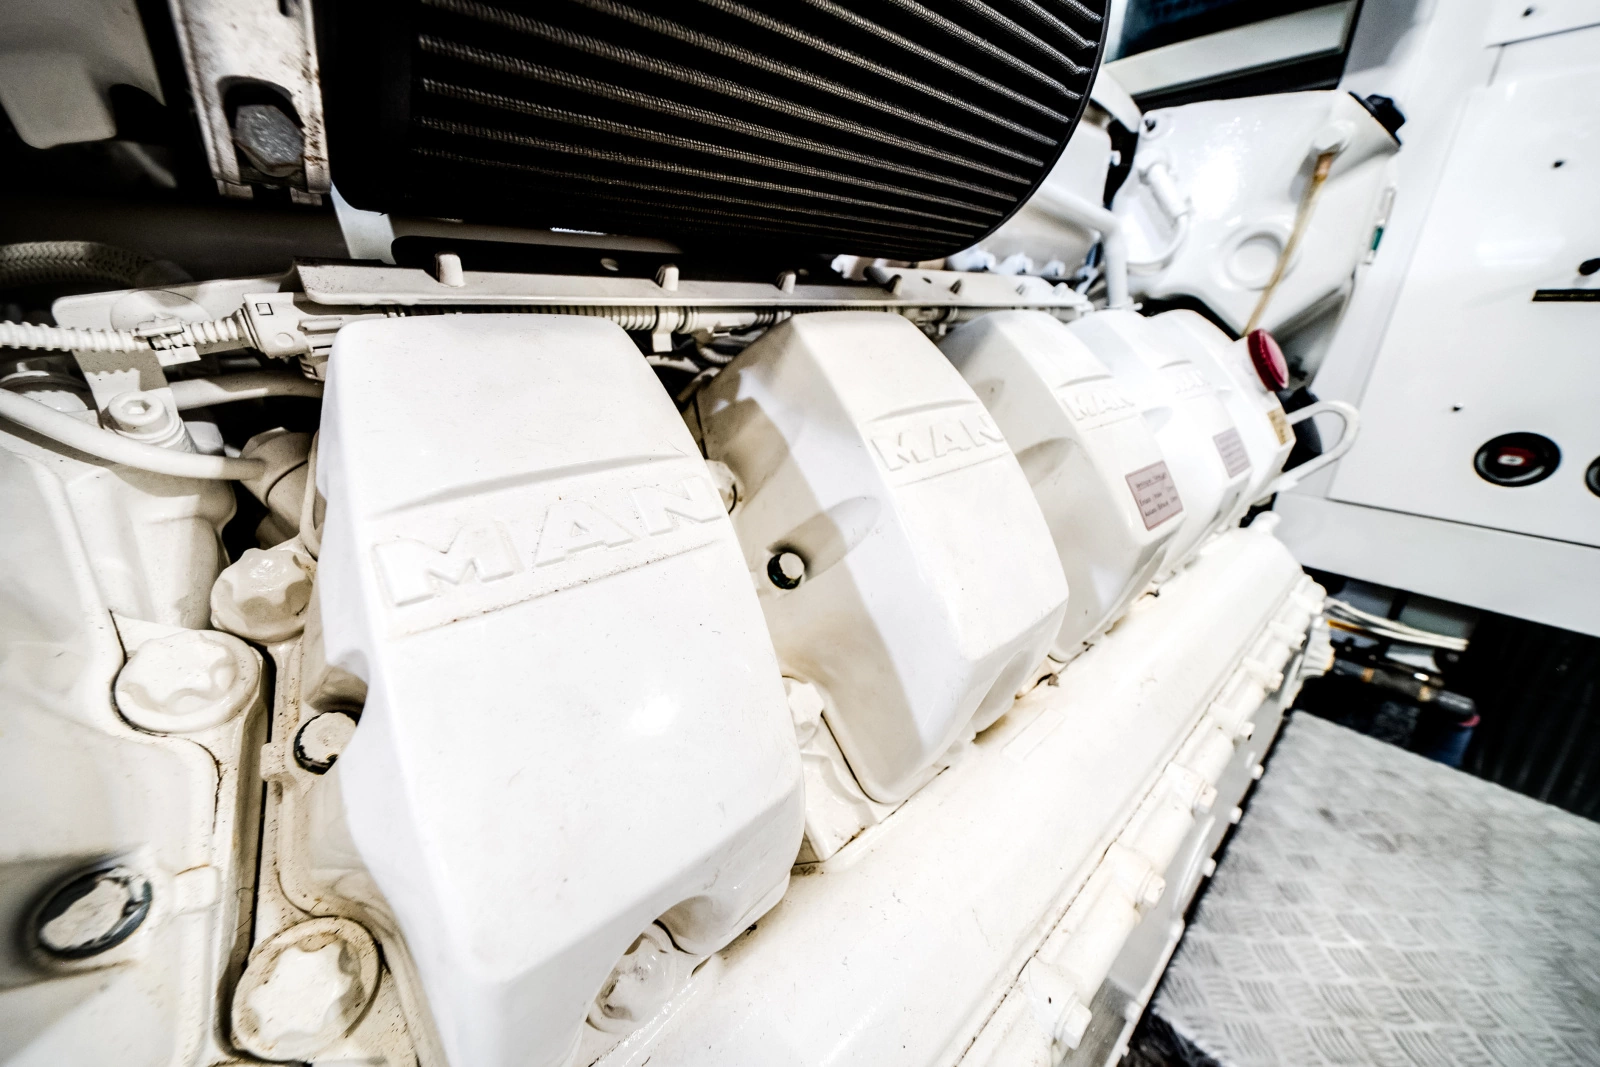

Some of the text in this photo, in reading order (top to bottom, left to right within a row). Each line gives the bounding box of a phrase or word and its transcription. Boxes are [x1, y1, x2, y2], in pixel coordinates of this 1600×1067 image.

[1061, 390, 1134, 421] MAN
[870, 412, 1004, 471] MAN
[372, 475, 722, 607] MAN
